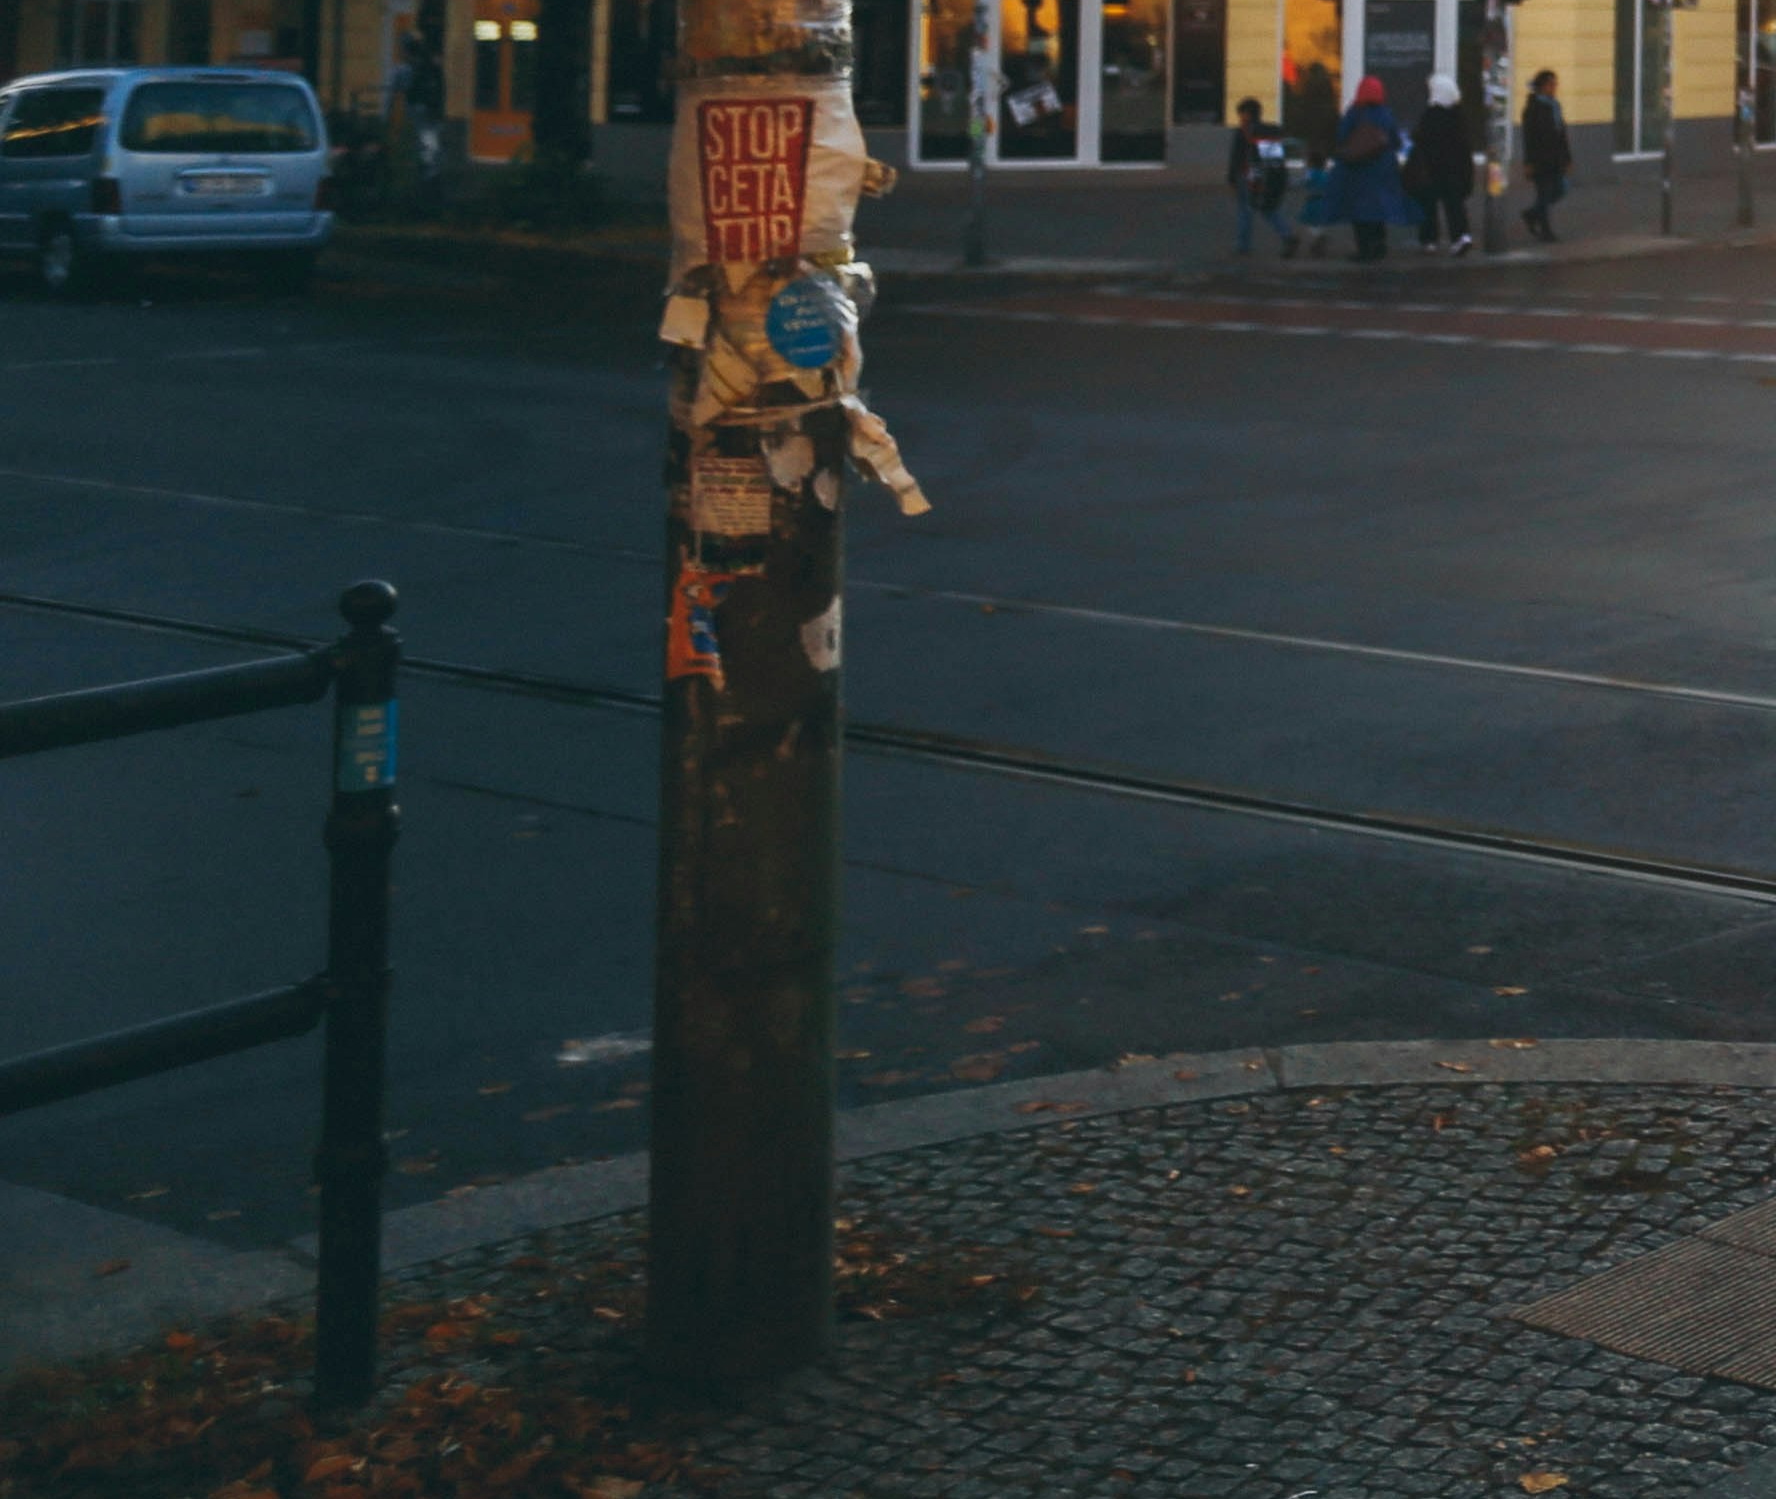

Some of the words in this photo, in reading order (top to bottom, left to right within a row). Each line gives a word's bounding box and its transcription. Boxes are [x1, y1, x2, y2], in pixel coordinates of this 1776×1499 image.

[705, 105, 802, 161] STOP
[707, 163, 797, 216] CETA
[711, 214, 795, 263] TTIP
